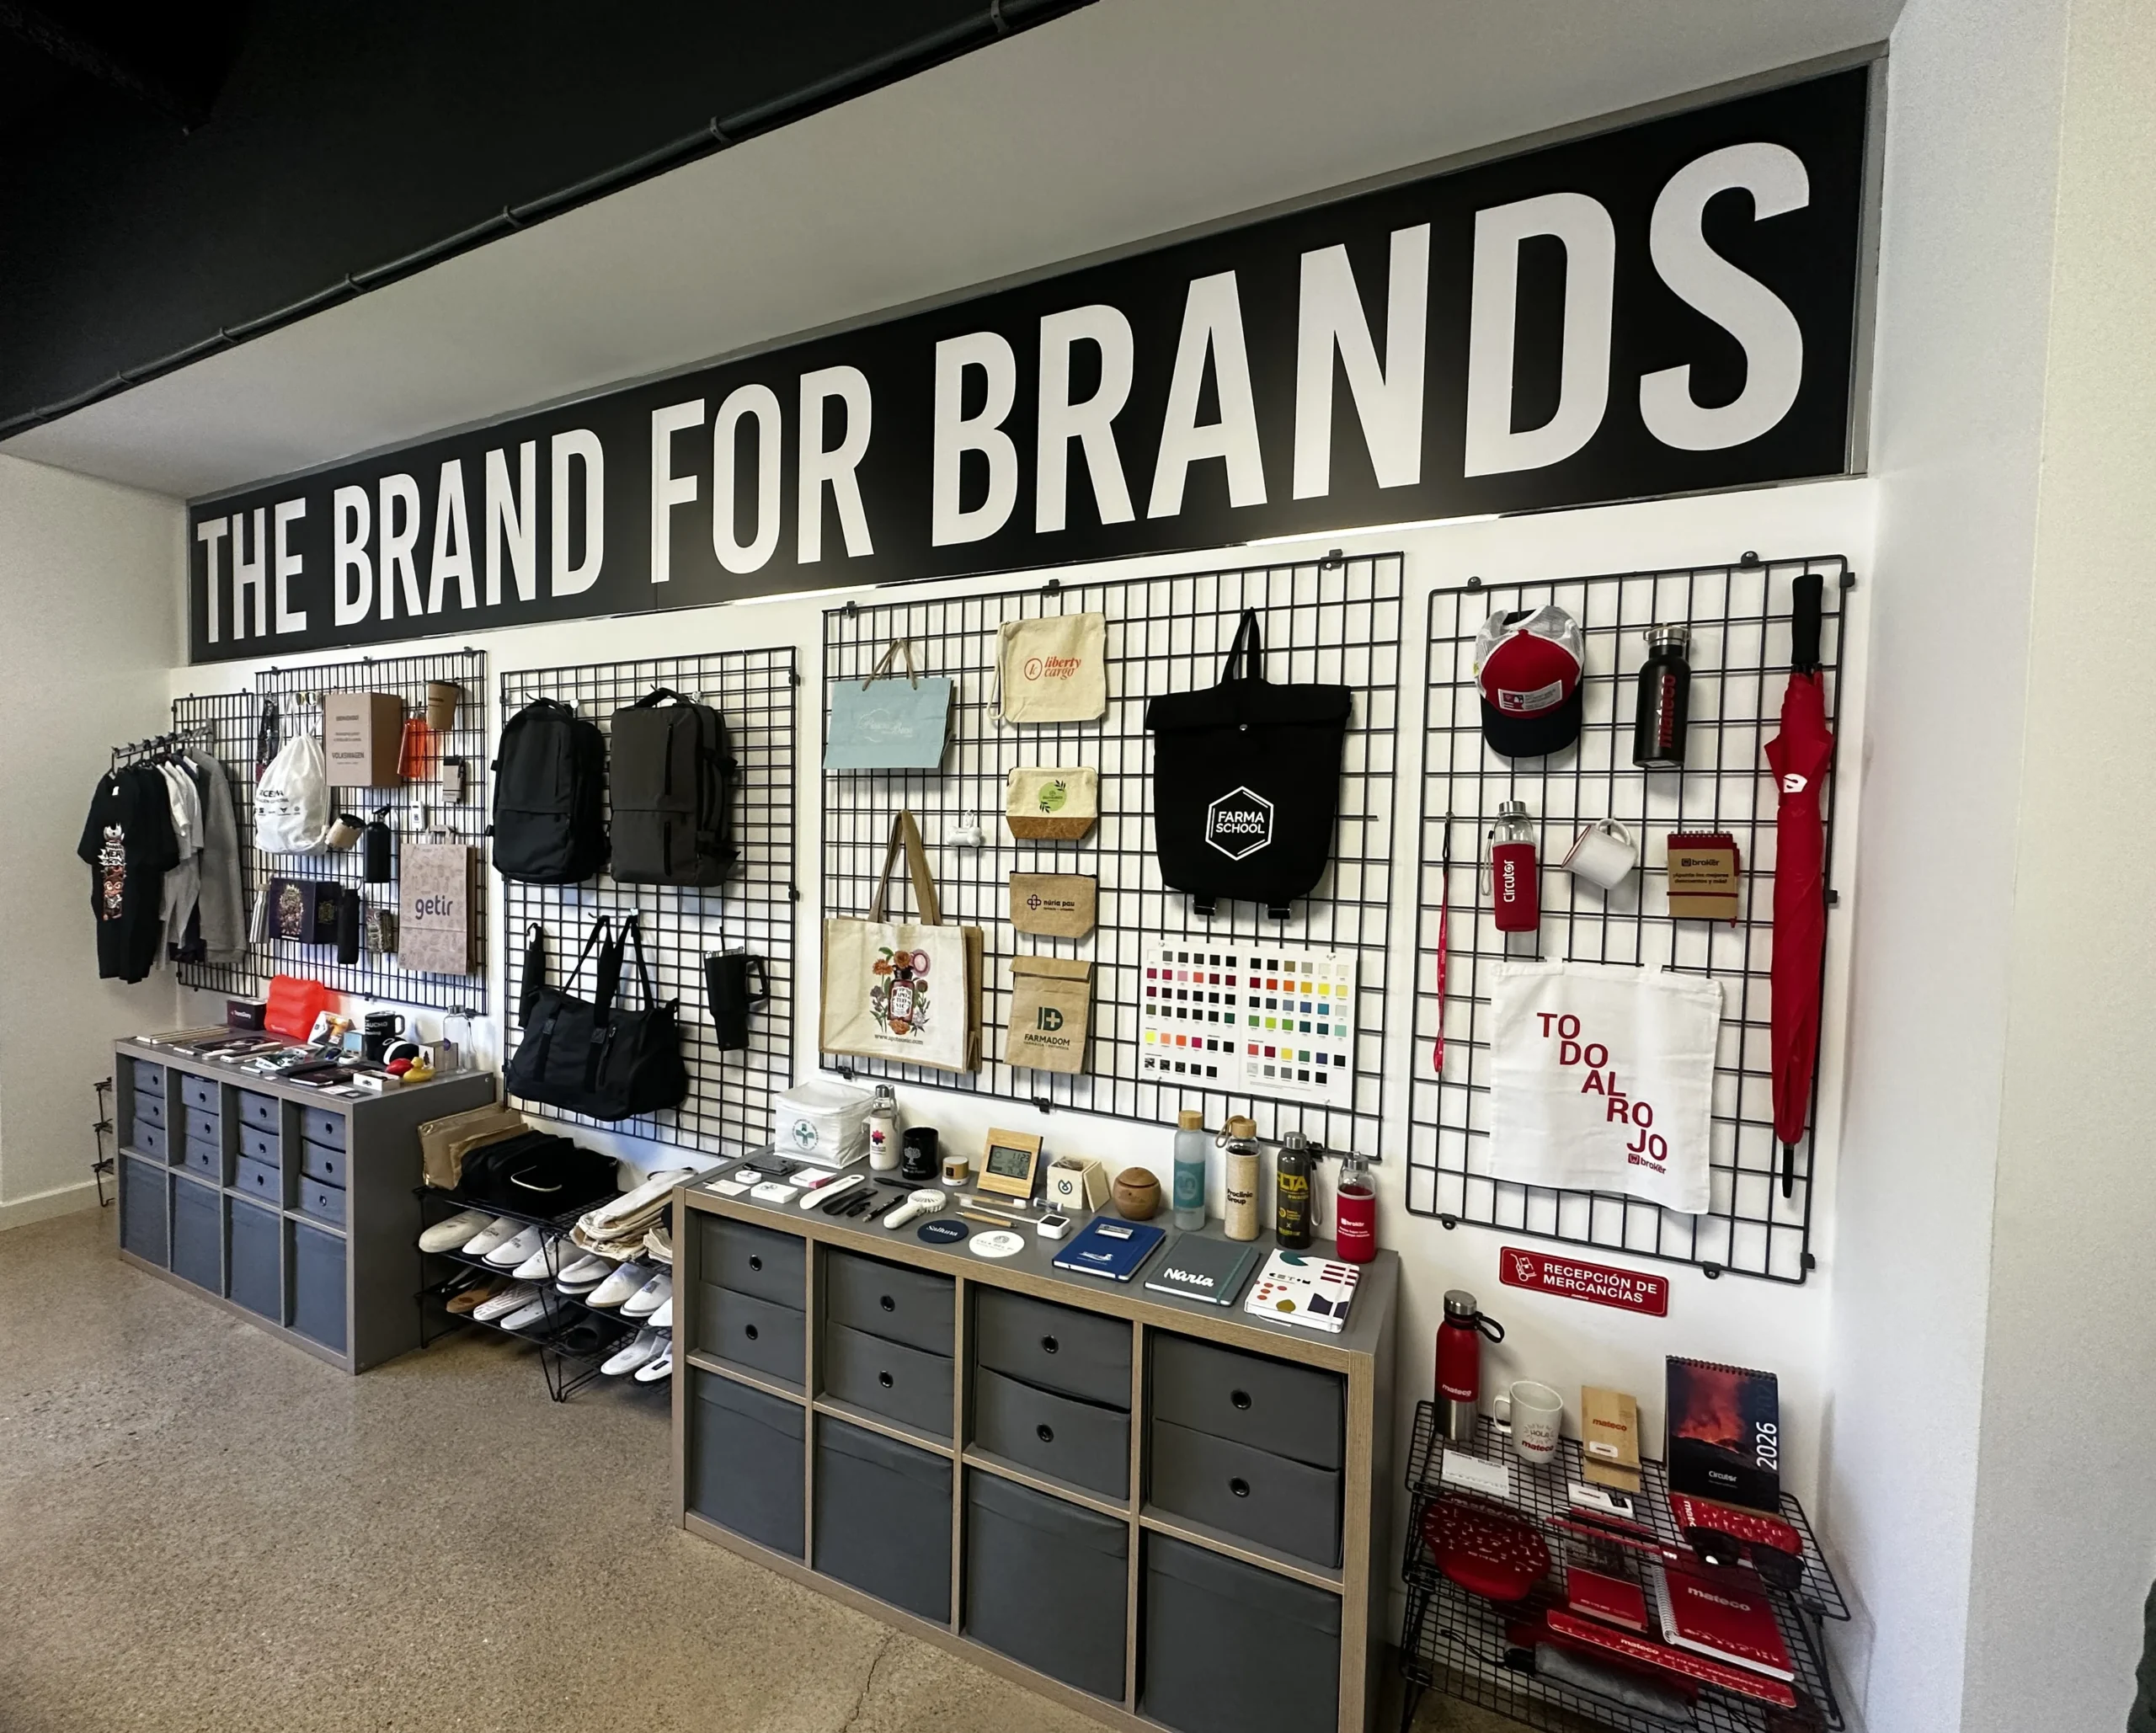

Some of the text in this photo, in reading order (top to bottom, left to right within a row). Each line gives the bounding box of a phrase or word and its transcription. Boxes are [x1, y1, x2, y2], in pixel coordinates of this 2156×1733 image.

[196, 142, 1810, 643] THE BRAND FOR BRANDS
[1044, 656, 1081, 669] liberty
[1044, 668, 1075, 680] cargo
[1657, 674, 1676, 749] mateco
[1215, 823, 1265, 834] SCHOOL
[1218, 811, 1265, 824] FARMA
[1502, 860, 1516, 903] Circutor
[414, 894, 454, 920] getir
[1537, 1012, 1581, 1040] TO
[1024, 1033, 1070, 1046] FARMADOM
[1560, 1041, 1609, 1069] DO
[1581, 1069, 1626, 1097] AL
[1607, 1097, 1653, 1128] RO
[1626, 1128, 1668, 1161] JO
[1641, 1158, 1667, 1175] broker
[1228, 1187, 1253, 1198] Proclinic
[1228, 1195, 1246, 1206] Group
[1543, 1262, 1657, 1295] RECEPCIÓN DE
[1543, 1274, 1644, 1304] MERCANCÍAS
[1442, 1384, 1472, 1397] mateco
[1592, 1418, 1627, 1432] mateco
[1522, 1440, 1554, 1452] mateco
[1755, 1421, 1778, 1471] 2026
[1688, 1586, 1752, 1612] mateco
[1620, 1638, 1659, 1656] mateco
